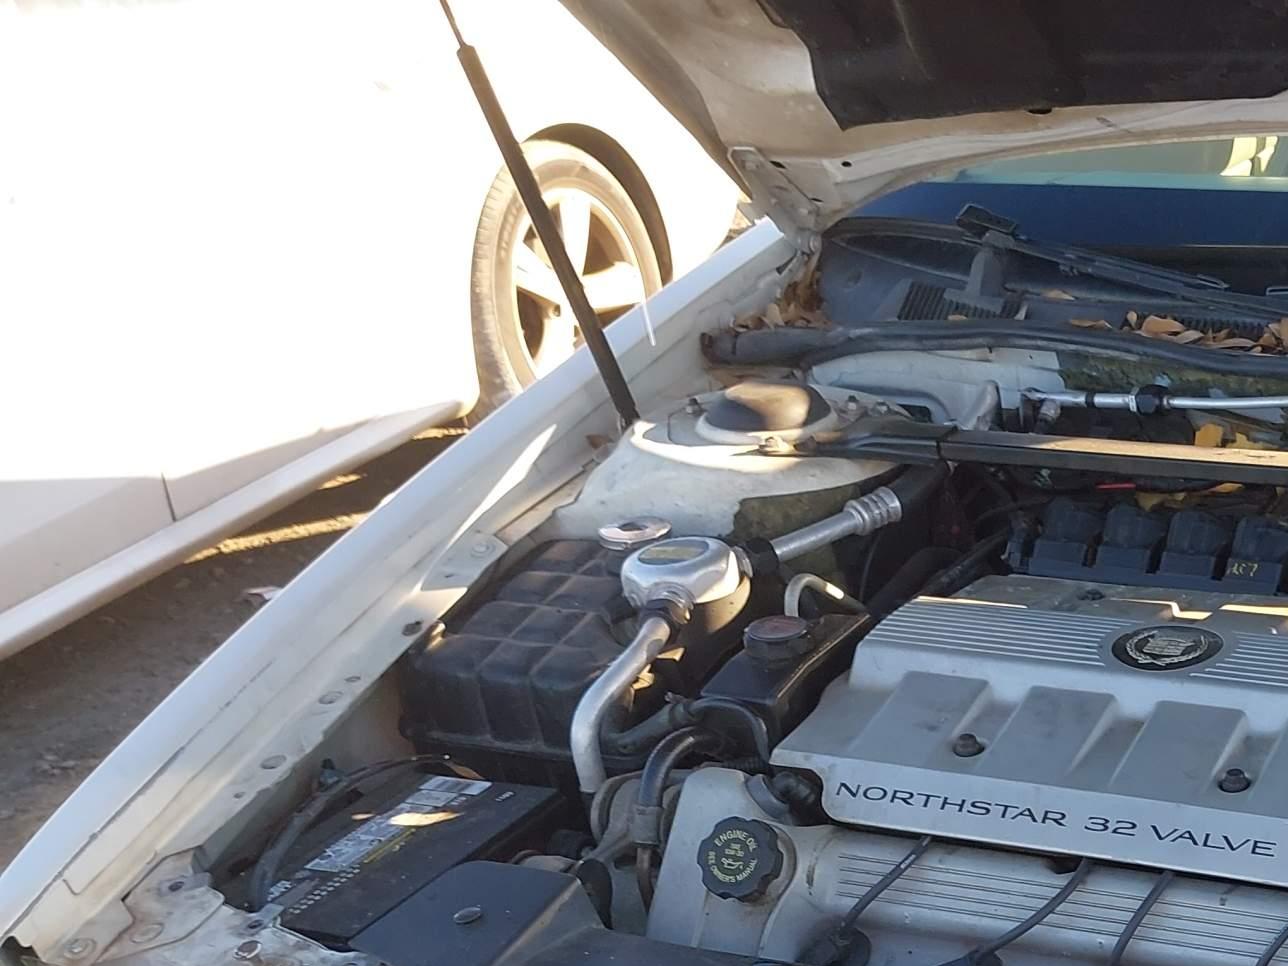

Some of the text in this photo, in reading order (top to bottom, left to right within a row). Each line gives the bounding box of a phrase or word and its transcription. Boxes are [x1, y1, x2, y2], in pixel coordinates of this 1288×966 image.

[714, 829, 749, 847] ENGINE
[836, 781, 1068, 827] NORTHSTAR
[1083, 816, 1138, 837] 32
[1150, 825, 1278, 858] VALVE
